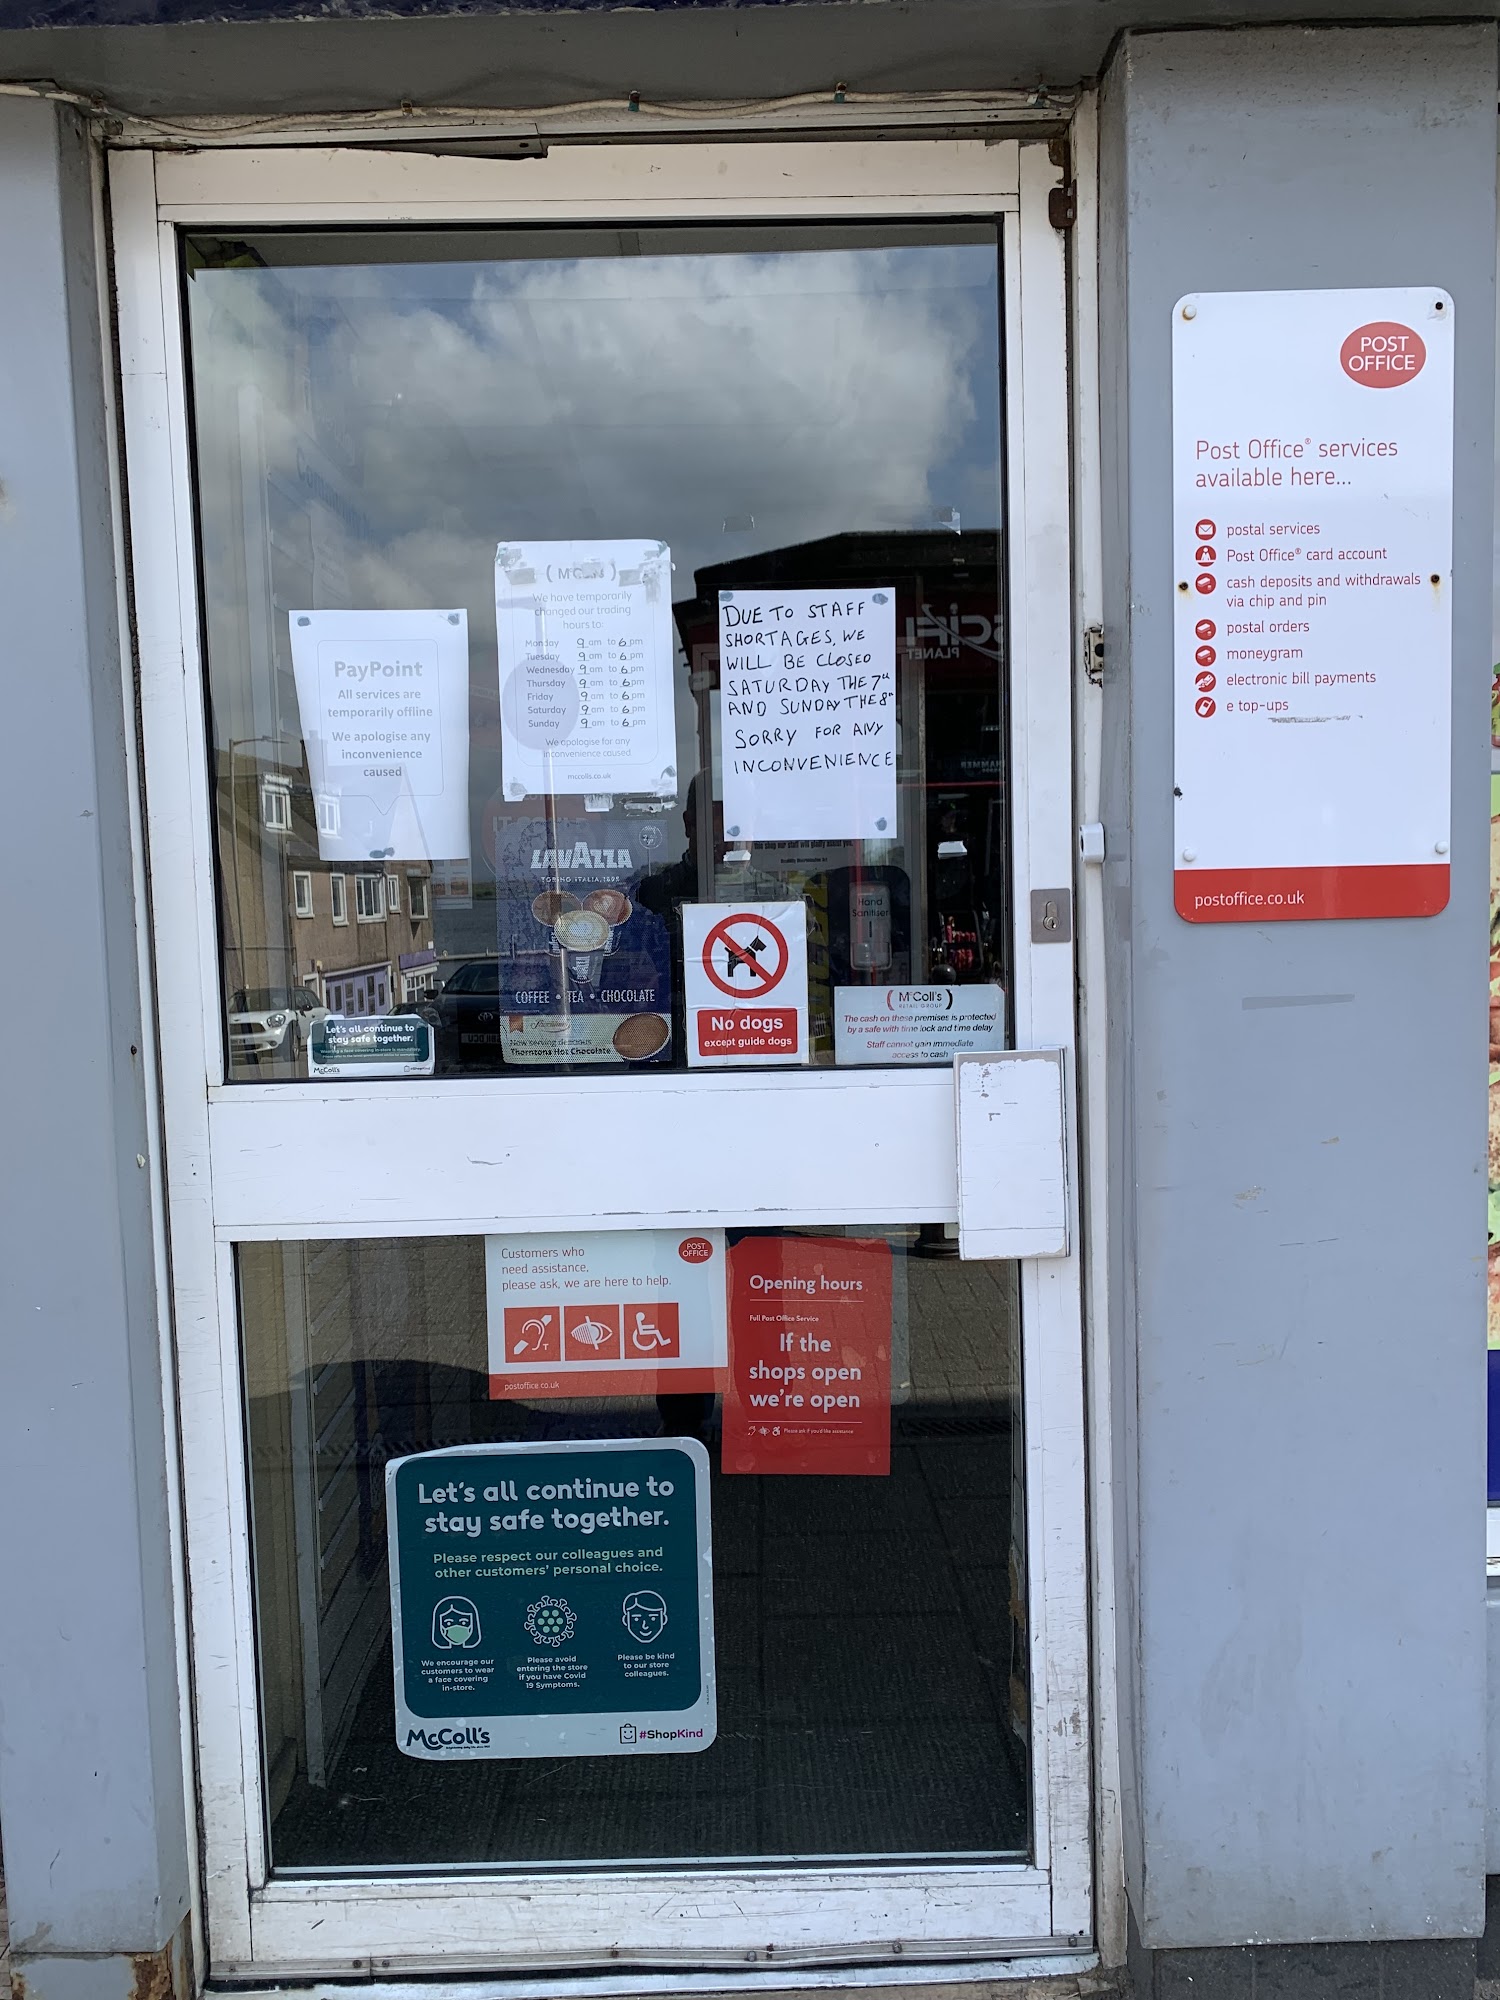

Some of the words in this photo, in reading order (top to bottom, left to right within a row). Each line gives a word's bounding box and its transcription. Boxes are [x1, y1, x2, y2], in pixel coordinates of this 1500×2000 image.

[1361, 336, 1409, 352] POST
[1348, 355, 1416, 371] OFFICE
[1196, 440, 1240, 460] Post
[1318, 438, 1398, 458] services
[1196, 467, 1282, 488] available
[1291, 466, 1352, 486] here...
[1226, 523, 1264, 538] postal
[1269, 522, 1320, 536] services
[1227, 549, 1255, 562] Post
[1306, 548, 1333, 561] card
[1338, 548, 1388, 560] account
[1226, 576, 1255, 588] cash
[1260, 575, 1312, 590] deposits
[1317, 574, 1340, 587] and
[1345, 572, 1421, 586] withdrawals
[532, 593, 548, 602] We
[550, 592, 574, 602] have
[576, 591, 632, 603] temporarily
[1226, 596, 1244, 608] via
[1249, 594, 1274, 610] chip
[1279, 594, 1302, 606] and
[1308, 594, 1327, 609] pin
[534, 607, 576, 618] changed
[597, 606, 631, 616] trading
[722, 604, 764, 628] DUE
[769, 605, 794, 622] TO
[808, 601, 866, 619] STAFF
[562, 620, 590, 630] hours
[592, 620, 604, 629] to:
[1226, 622, 1264, 636] postal
[1270, 620, 1310, 634] orders
[726, 629, 836, 648] SHORTAGES,
[843, 629, 866, 642] WE
[726, 655, 772, 671] WILL
[784, 653, 806, 670] BE
[1226, 648, 1303, 662] moneygram
[334, 660, 423, 682] PayPoint
[726, 677, 830, 697] SATURDAY
[836, 674, 868, 690] THE
[1226, 673, 1288, 686] electronic
[1292, 672, 1310, 684] bill
[1314, 672, 1376, 687] payments
[338, 689, 353, 700] All
[356, 689, 400, 700] services
[403, 690, 421, 700] are
[328, 707, 394, 720] temporarily
[396, 706, 432, 718] offline
[728, 700, 767, 717] AND
[780, 698, 841, 716] SUNDAY
[844, 694, 877, 709] THE
[1226, 702, 1234, 712] e
[1238, 700, 1289, 714] top-ups
[332, 731, 351, 742] We
[354, 732, 408, 744] apologise
[410, 732, 430, 744] any
[735, 728, 798, 750] SORRY
[815, 723, 842, 740] FOR
[853, 721, 884, 737] ANY
[341, 748, 422, 760] inconvenience
[734, 751, 894, 775] INCONVENIENCE
[363, 766, 402, 778] caused
[530, 842, 634, 870] LAVAZZA
[858, 898, 882, 906] Hand
[1194, 890, 1304, 910] postoffice.co.uk
[852, 908, 889, 918] Sanitiser
[516, 990, 550, 1004] COFFEE
[567, 990, 584, 1003] TEA
[601, 989, 655, 1002] CHOCOLATE
[899, 990, 942, 1002] McColl's
[711, 1016, 735, 1032] No
[740, 1014, 784, 1033] dogs
[844, 1014, 858, 1023] The
[860, 1014, 878, 1022] cash
[892, 1014, 914, 1022] these
[914, 1014, 950, 1024] premises
[951, 1013, 958, 1021] is
[959, 1013, 997, 1022] protected
[348, 1025, 362, 1034] all
[364, 1024, 403, 1033] continue
[404, 1024, 414, 1032] to
[328, 1036, 349, 1046] stay
[350, 1035, 370, 1044] safe
[373, 1034, 414, 1044] together.
[704, 1038, 736, 1048] except
[738, 1036, 766, 1048] guide
[768, 1036, 792, 1048] dogs
[314, 1066, 340, 1074] McColl's
[502, 1247, 558, 1260] Customers
[562, 1246, 584, 1258] who
[682, 1250, 708, 1258] OFFICE
[502, 1264, 528, 1274] need
[502, 1279, 536, 1292] please
[564, 1280, 580, 1288] we
[584, 1279, 601, 1288] are
[604, 1276, 628, 1288] here
[632, 1276, 643, 1286] to
[646, 1275, 672, 1288] help.
[750, 1274, 816, 1294] Opening
[820, 1274, 863, 1291] hours
[780, 1332, 794, 1352] If
[800, 1332, 832, 1352] the
[749, 1360, 806, 1386] shops
[811, 1367, 862, 1386] open
[504, 1380, 560, 1391] postoffice.co.uk
[810, 1394, 860, 1414] open
[483, 1480, 519, 1502] all
[526, 1478, 640, 1502] continue
[646, 1476, 674, 1498] to
[424, 1511, 482, 1538] stay
[489, 1508, 545, 1532] safe
[551, 1506, 670, 1534] together.
[433, 1552, 478, 1564] Please
[481, 1552, 532, 1565] respect
[536, 1551, 558, 1562] our
[562, 1548, 634, 1563] colleagues
[638, 1546, 664, 1558] and
[434, 1568, 471, 1579] other
[553, 1562, 611, 1576] personal
[615, 1561, 663, 1573] choice.
[617, 1653, 643, 1661] Please
[645, 1652, 656, 1660] be
[658, 1652, 675, 1660] kind
[624, 1670, 669, 1678] colleagues.
[406, 1726, 491, 1750] McColl's
[639, 1728, 704, 1741] #ShopKind
